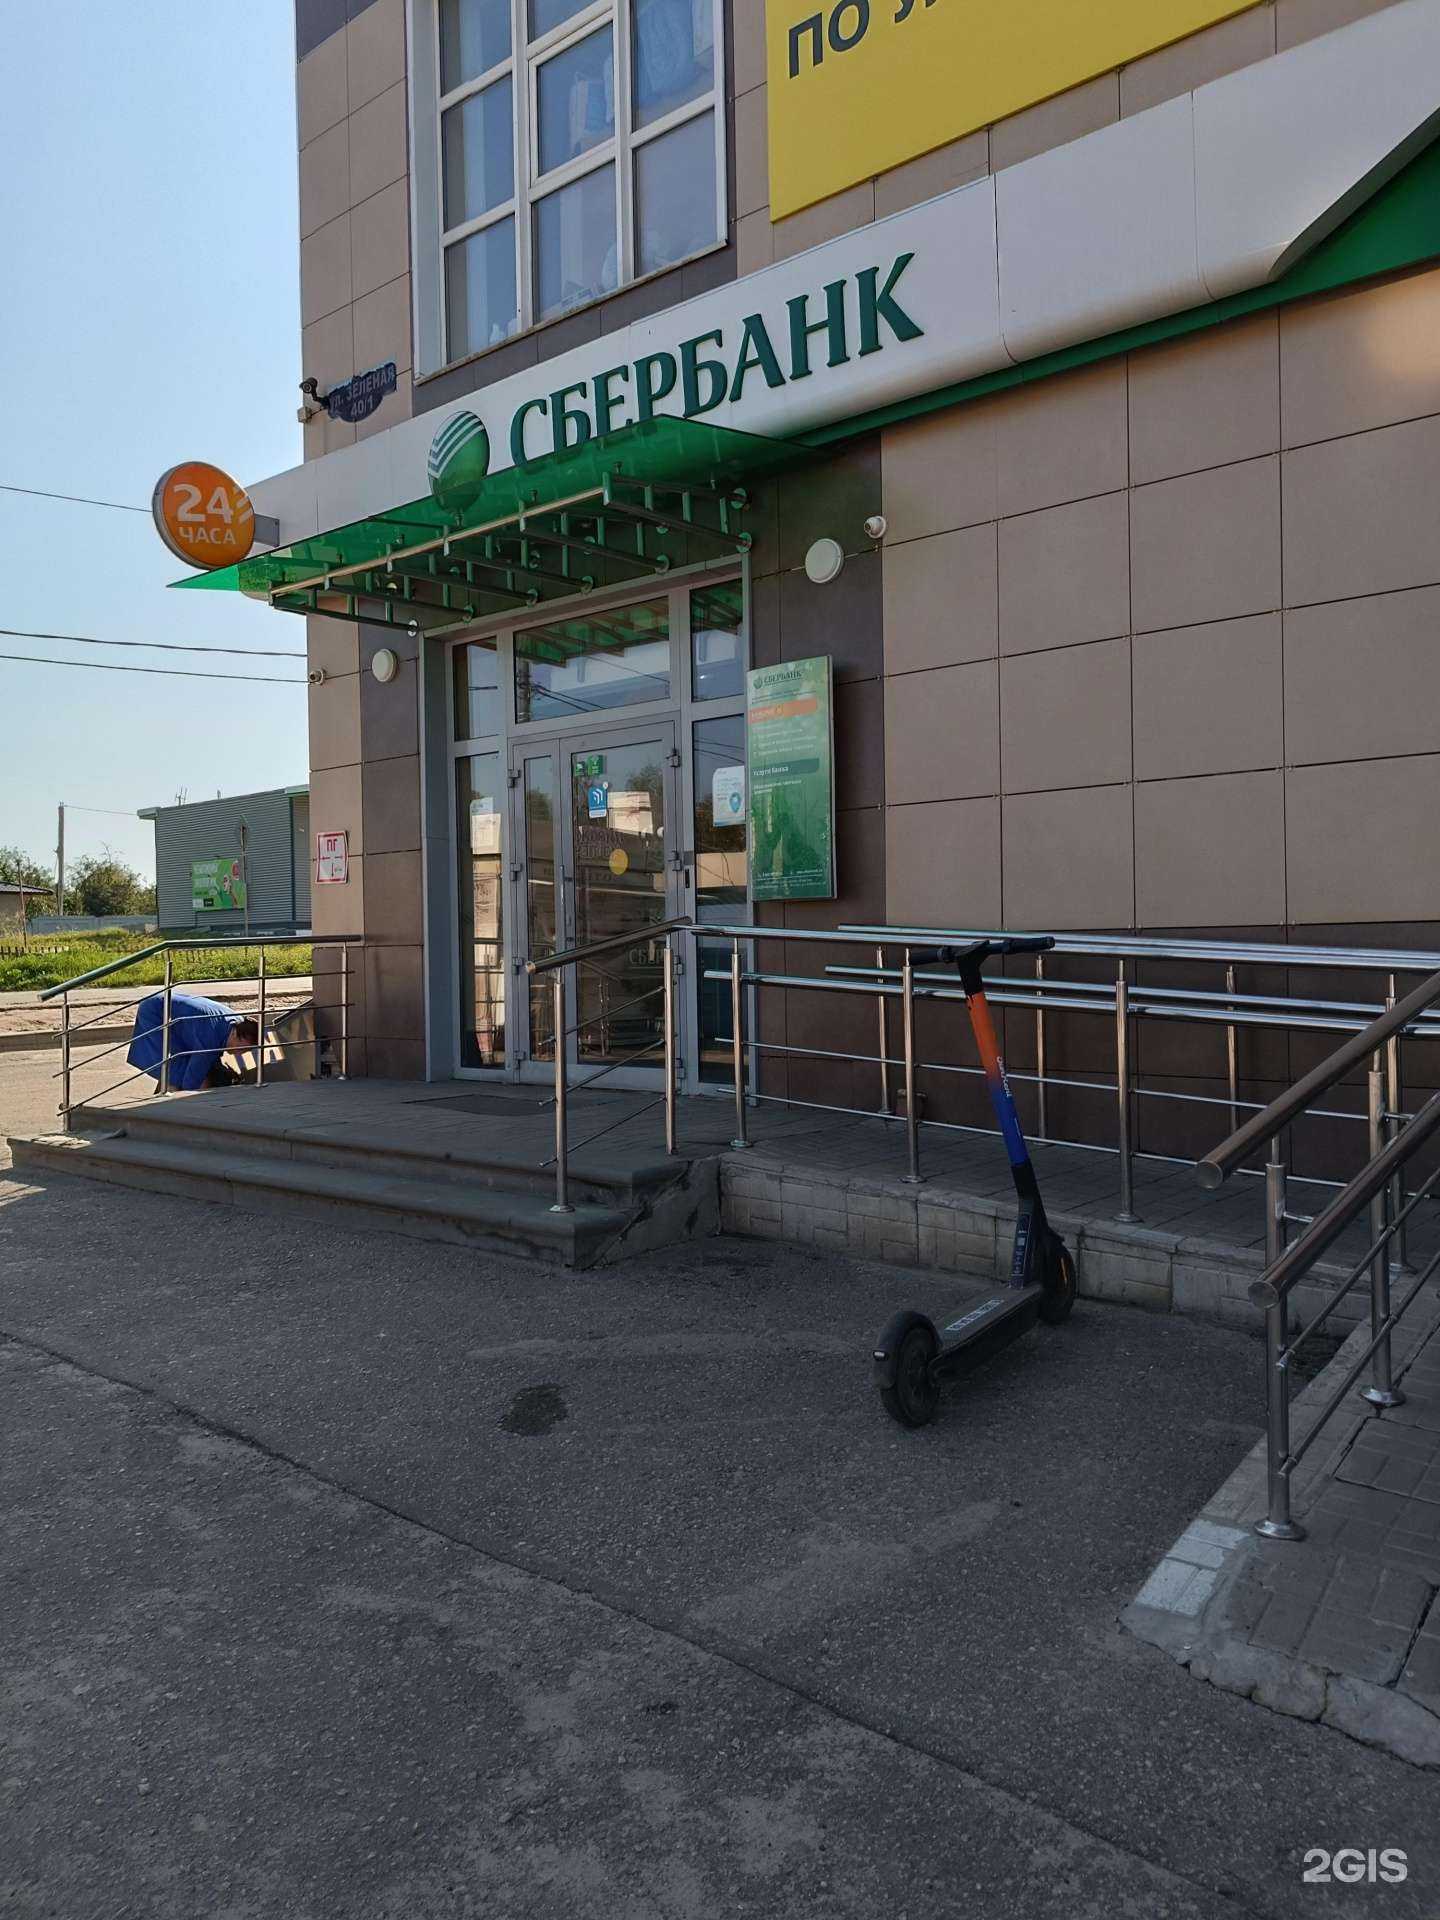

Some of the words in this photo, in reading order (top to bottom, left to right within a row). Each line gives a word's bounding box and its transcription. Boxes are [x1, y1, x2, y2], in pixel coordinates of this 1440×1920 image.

[509, 252, 924, 468] СБЕРБАНК
[351, 395, 373, 416] 40/1
[173, 484, 234, 525] 24
[178, 526, 237, 545] ЧАСА
[327, 838, 338, 852] ПГ
